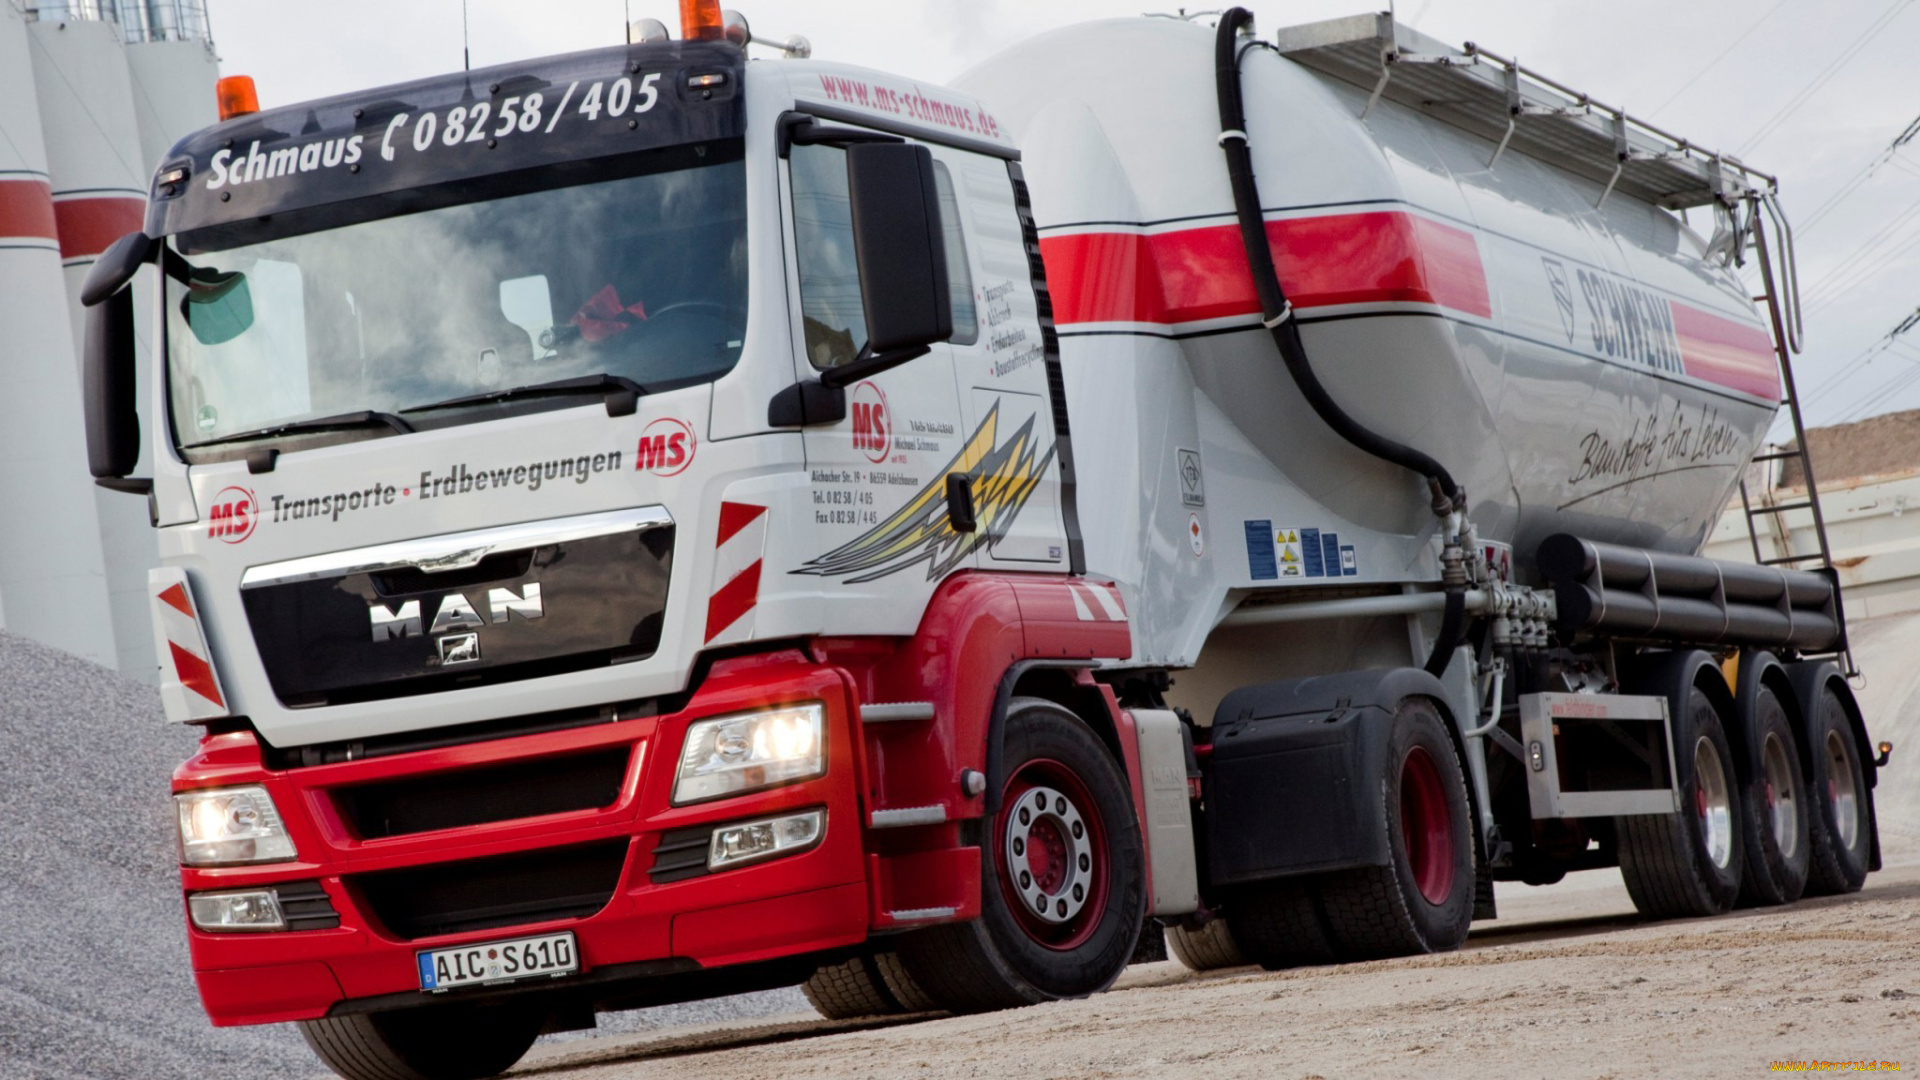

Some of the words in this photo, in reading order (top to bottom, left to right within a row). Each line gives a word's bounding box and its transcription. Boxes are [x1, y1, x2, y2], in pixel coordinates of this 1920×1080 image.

[819, 74, 1000, 139] www.ms-schmaus.de
[206, 135, 363, 190] Schmaus
[1576, 268, 1683, 375] SCHWENK
[853, 402, 885, 451] MS
[894, 436, 916, 451] Michael
[917, 437, 940, 452] Schmaus
[1690, 403, 1740, 464] Leben
[635, 432, 686, 472] MS
[271, 482, 396, 523] Transporte
[419, 450, 622, 499] Erdbewegungen
[811, 470, 841, 483] Aichacher
[842, 470, 853, 483] Str.
[870, 471, 887, 484] 86559
[813, 491, 825, 504] Tel.
[207, 500, 250, 538] MS
[816, 510, 828, 523] Fax
[369, 582, 545, 642] MAN
[437, 951, 485, 983] AIC
